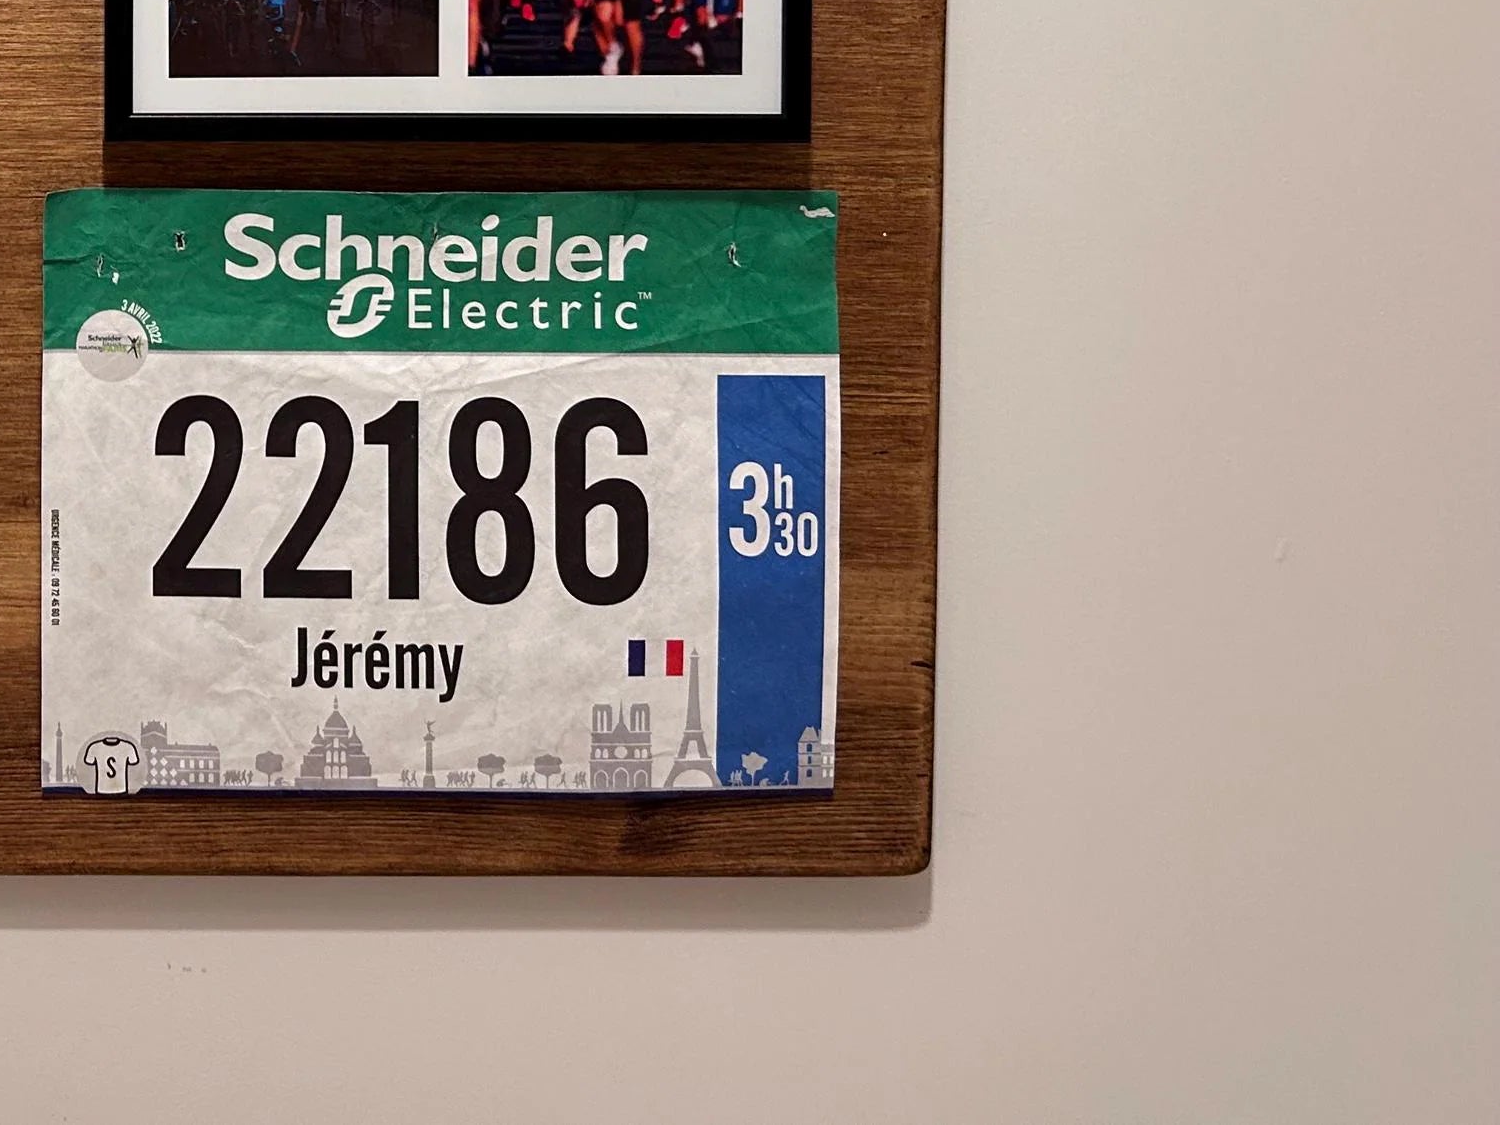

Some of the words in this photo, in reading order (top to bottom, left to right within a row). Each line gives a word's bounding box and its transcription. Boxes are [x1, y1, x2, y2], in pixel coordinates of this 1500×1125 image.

[223, 212, 649, 282] Schneider
[120, 298, 128, 312] 3
[127, 302, 151, 325] AVRIL
[145, 320, 163, 345] 2022
[407, 288, 639, 330] Electric
[151, 394, 650, 606] 22186
[290, 626, 464, 703] Jérémy
[106, 756, 117, 779] S
